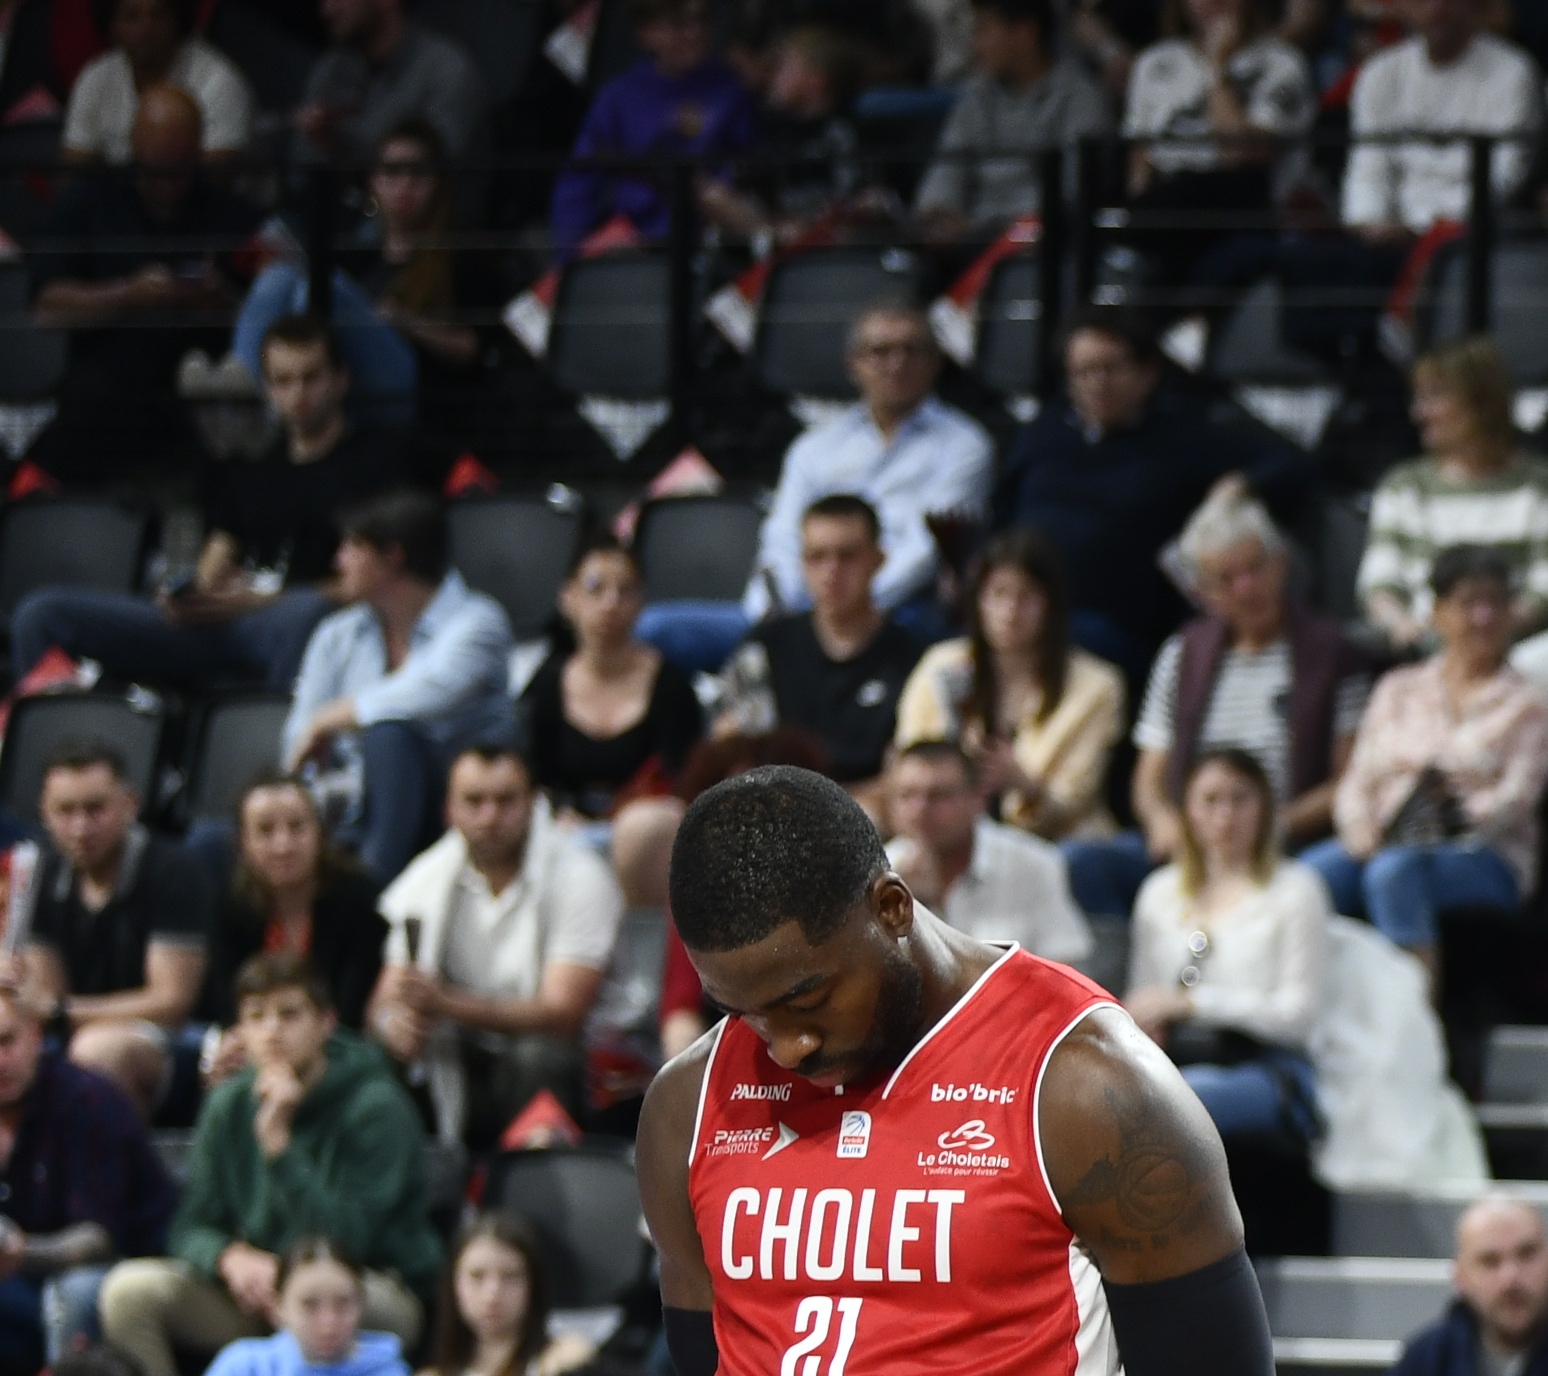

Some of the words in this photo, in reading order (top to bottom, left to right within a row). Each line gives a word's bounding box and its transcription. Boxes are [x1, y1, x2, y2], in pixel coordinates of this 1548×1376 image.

[730, 1083, 792, 1102] PALDING
[918, 1152, 936, 1167] Le
[938, 1151, 1010, 1168] Choletais
[721, 1186, 965, 1283] CHOLET
